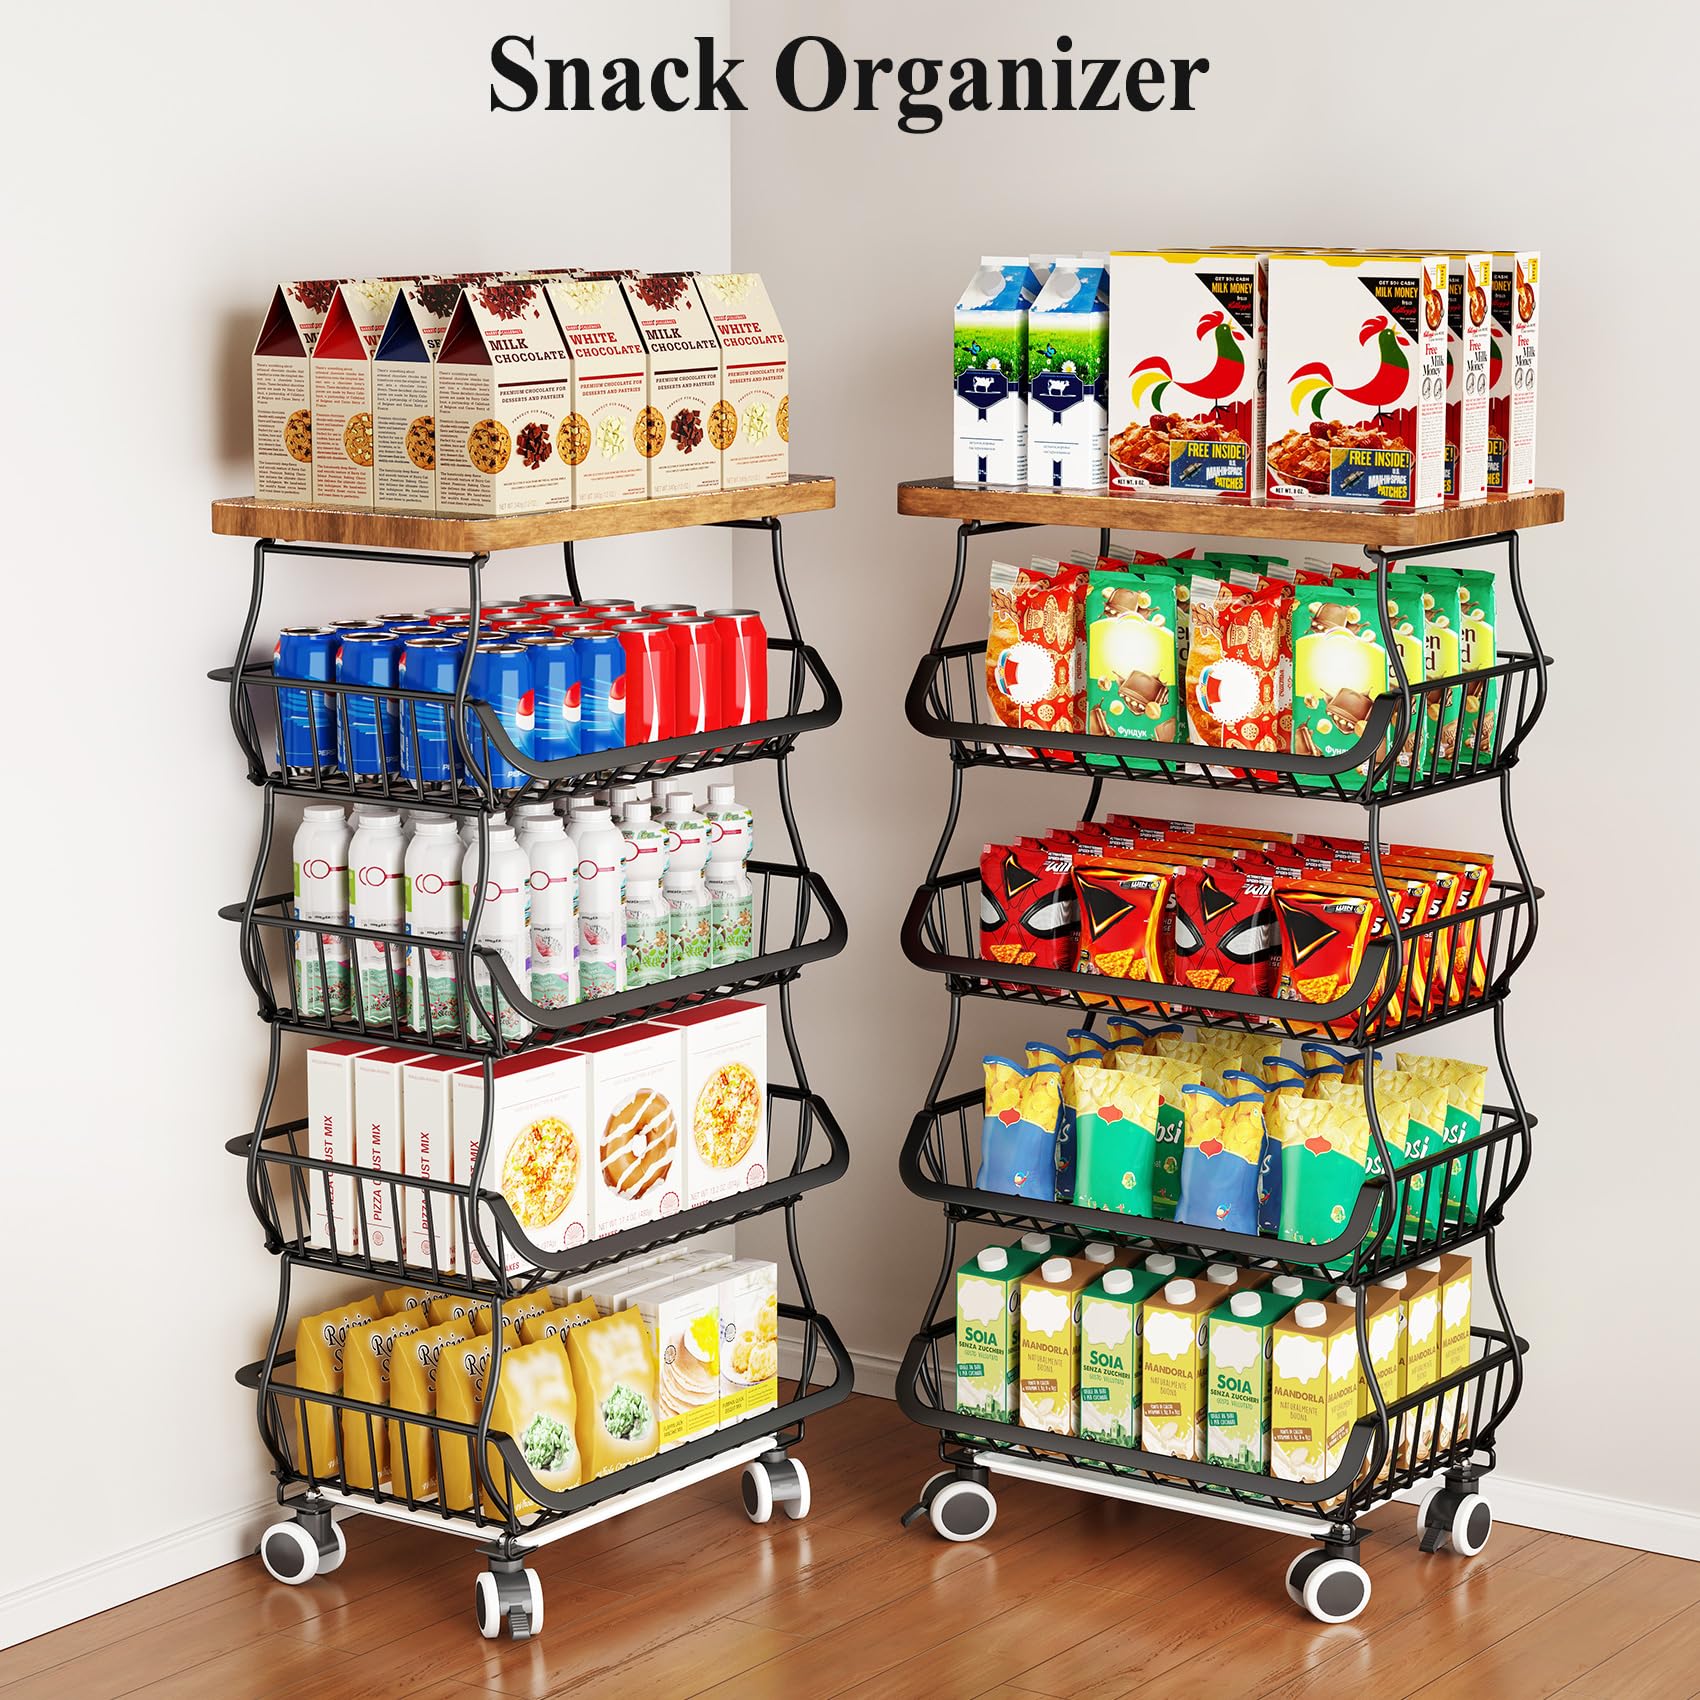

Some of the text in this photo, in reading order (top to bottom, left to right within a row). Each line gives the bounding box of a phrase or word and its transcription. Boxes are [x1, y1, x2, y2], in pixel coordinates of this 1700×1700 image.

[1211, 282, 1252, 294] MILK MONEY
[1375, 286, 1419, 299] MILK MONEY
[1449, 284, 1463, 295] NEY
[645, 328, 682, 340] MILK
[717, 322, 762, 335] WHITE
[488, 338, 529, 351] MILK
[569, 332, 618, 345] WHITE
[651, 339, 717, 352] CHOCOLATE
[723, 334, 785, 347] CHOCOLATE
[1469, 339, 1482, 351] Free
[1517, 335, 1529, 347] Free
[575, 344, 642, 358] CHOCOLATE
[1425, 343, 1438, 356] Free
[1522, 346, 1536, 358] Milk
[494, 350, 566, 364] CHOCOLATE
[1431, 355, 1445, 367] Milk
[1474, 351, 1488, 363] Milk
[1515, 355, 1532, 367] Money
[1423, 363, 1440, 377] Money
[1467, 360, 1484, 372] Money
[1188, 443, 1245, 459] FREE INSIDE!
[1349, 450, 1409, 468] FREE INSIDE!
[1214, 477, 1244, 490] PATCHES
[1377, 485, 1407, 499] PATCHES
[1117, 725, 1147, 738] Фундук
[324, 1115, 333, 1137] MIX
[420, 1132, 430, 1154] MIX
[371, 1123, 382, 1221] PIZZA CUST MIX
[505, 1262, 520, 1271] AKES
[965, 1327, 998, 1346] SOIA
[1443, 1330, 1469, 1347] MANDORLA
[959, 1341, 1005, 1356] SENZA ZUCCHERI
[1022, 1339, 1069, 1356] MANDORLA
[464, 1346, 512, 1377] Rain
[1090, 1350, 1124, 1370] SOIA
[1408, 1346, 1436, 1364] MANDORLA
[1083, 1365, 1131, 1379] SENZA ZUCCHERI
[1144, 1362, 1193, 1380] MANDORLA
[1375, 1364, 1397, 1381] NDORLA
[1217, 1374, 1253, 1395] SOIA
[1327, 1383, 1357, 1400] MANDORLA
[1210, 1388, 1260, 1404] SENZA ZUCCHERI
[1273, 1386, 1325, 1405] MANDORLA
